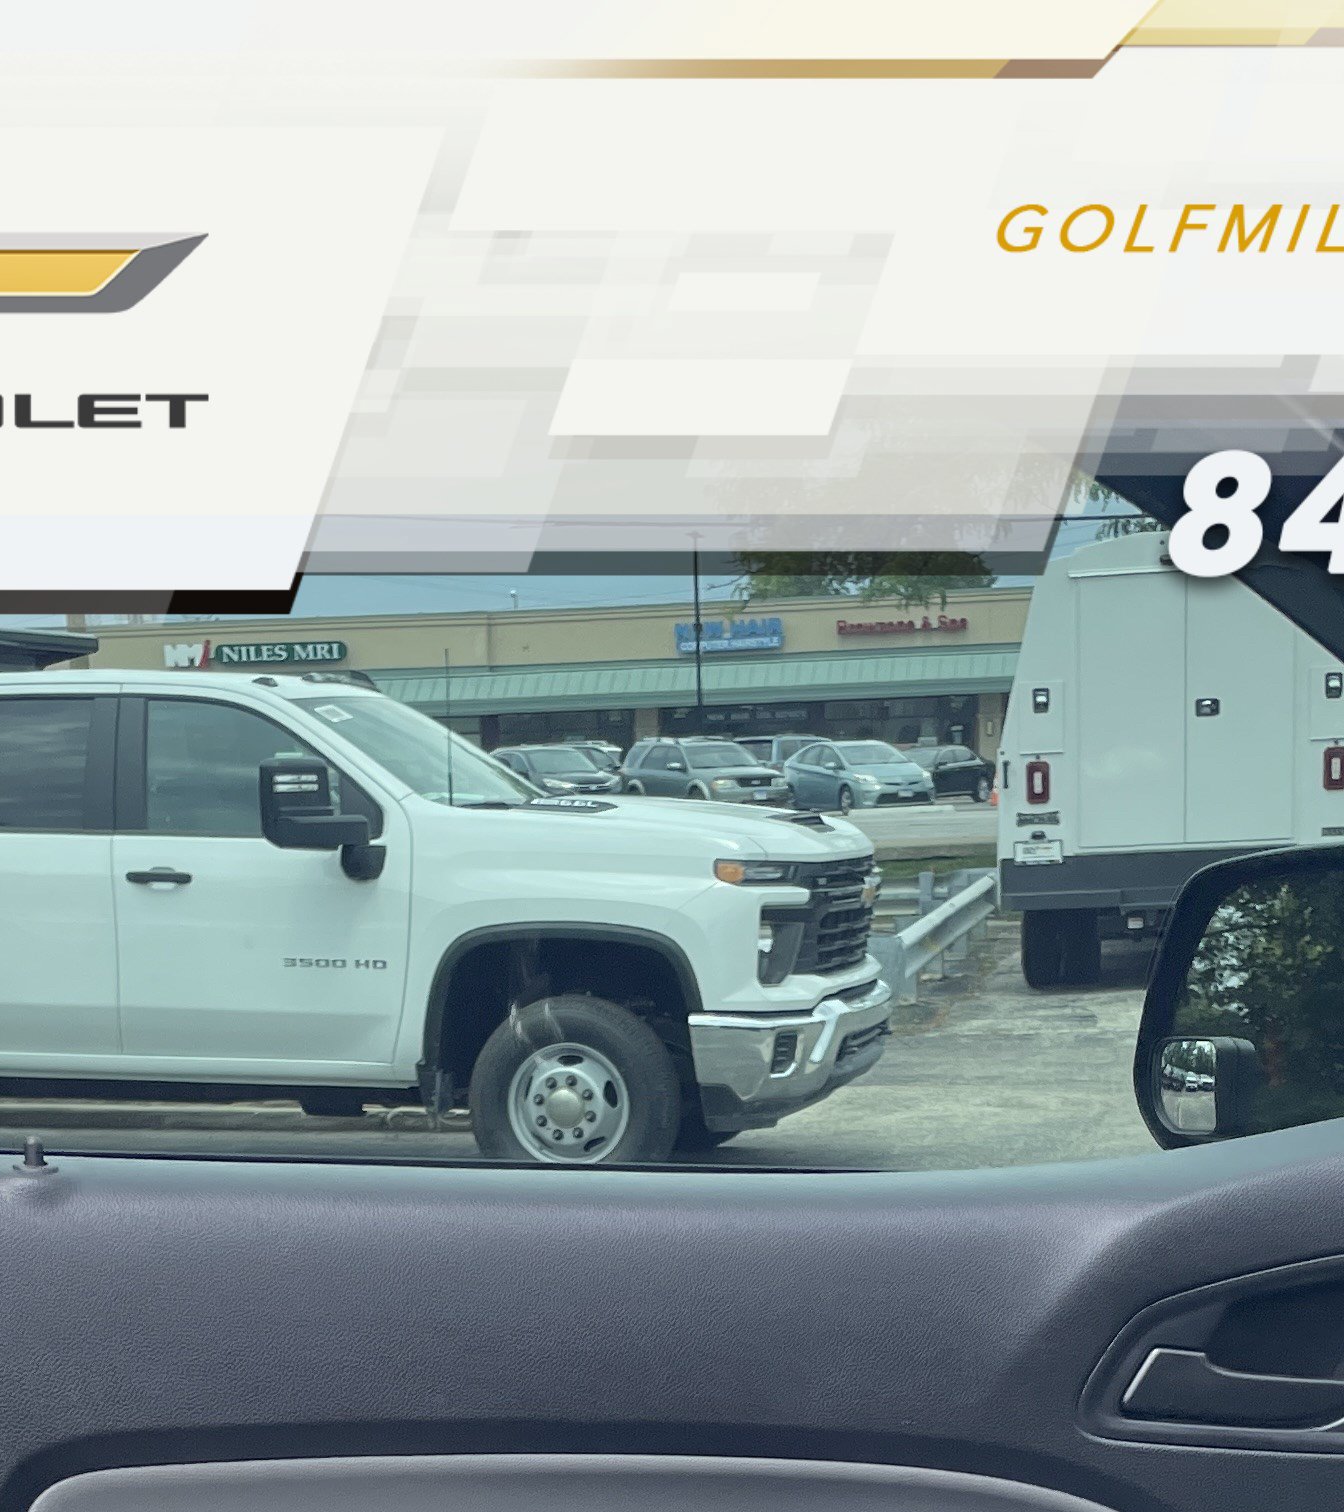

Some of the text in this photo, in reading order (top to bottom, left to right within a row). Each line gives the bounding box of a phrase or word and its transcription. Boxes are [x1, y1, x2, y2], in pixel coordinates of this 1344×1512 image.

[222, 644, 288, 663] NILES
[293, 643, 341, 661] MRI
[282, 957, 387, 969] 3500 HD
